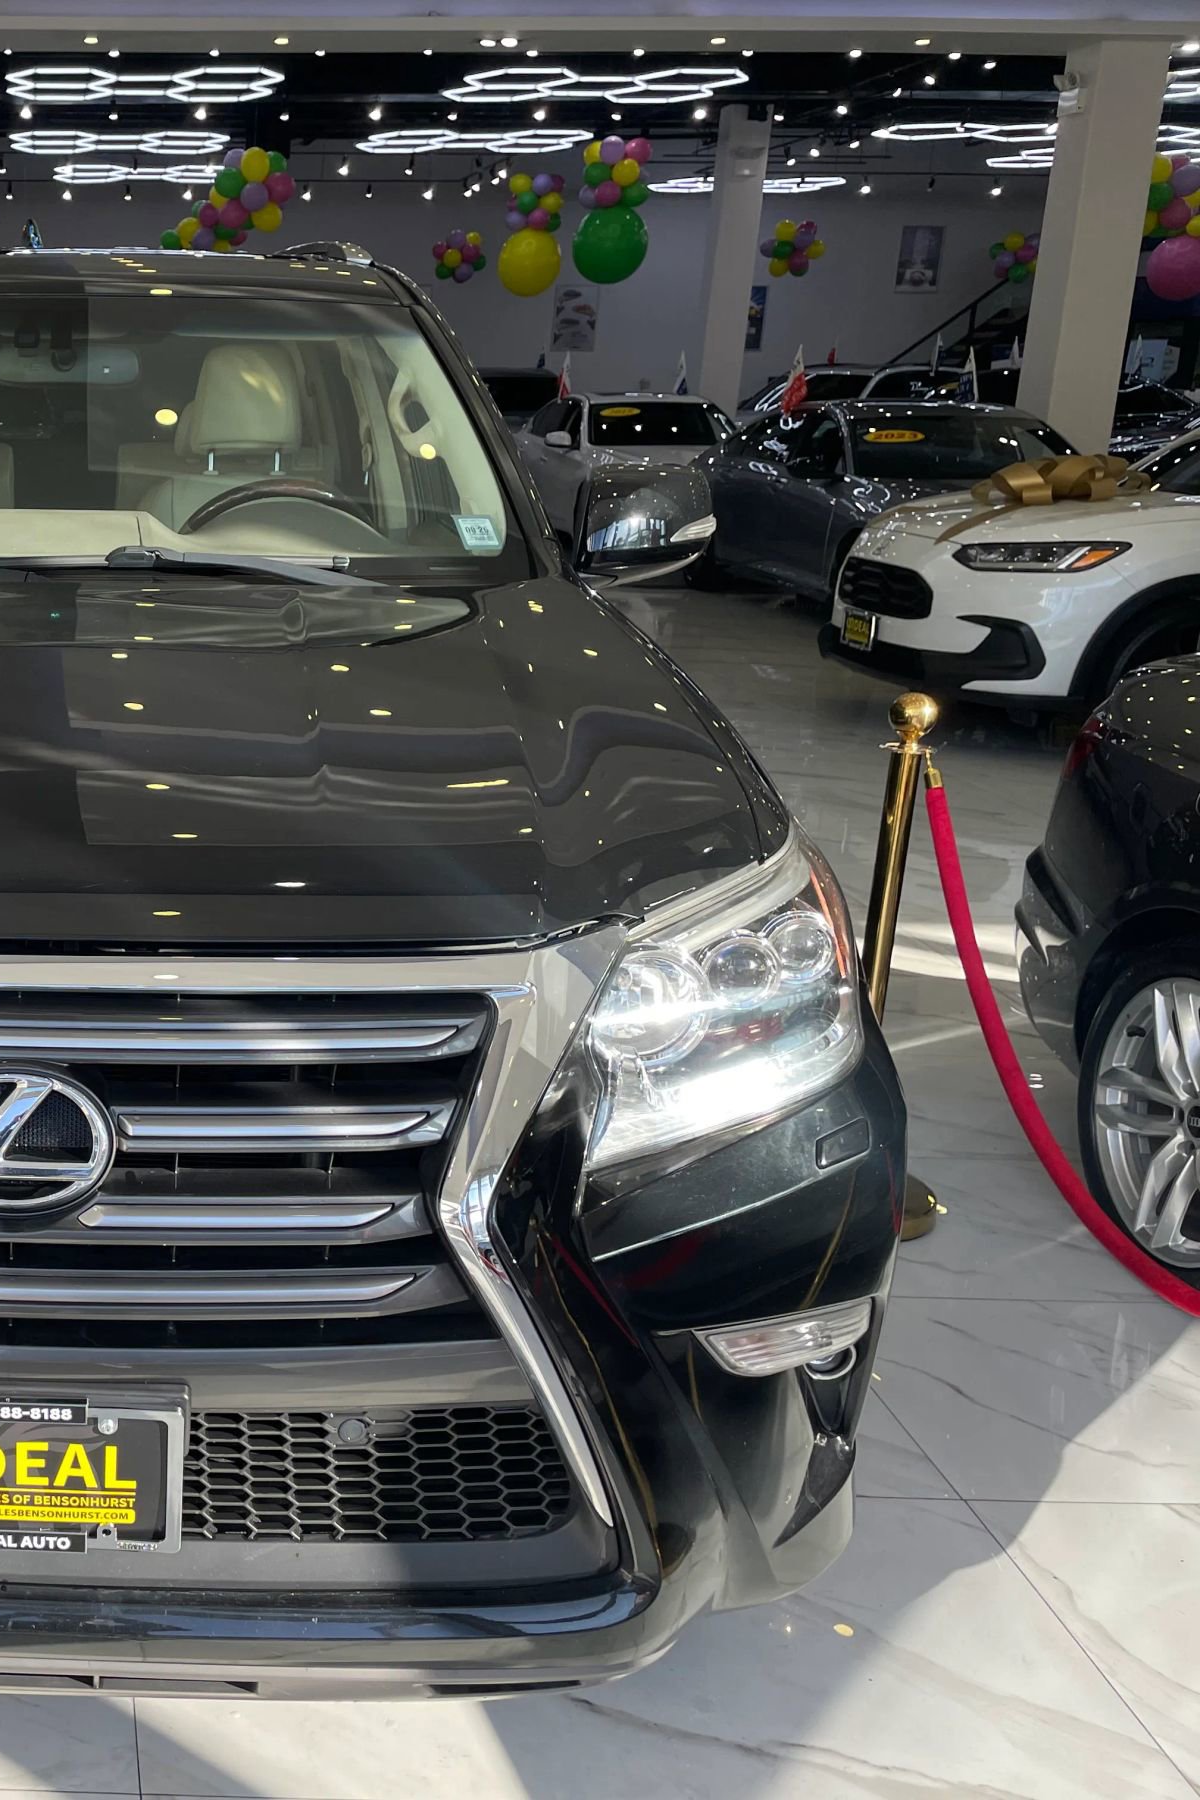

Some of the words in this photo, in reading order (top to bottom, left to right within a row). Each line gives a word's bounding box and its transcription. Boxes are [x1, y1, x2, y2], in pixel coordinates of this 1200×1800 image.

[12, 1494, 31, 1505] OF
[34, 1495, 135, 1508] BENSONHURST
[20, 1536, 71, 1550] AUTO
